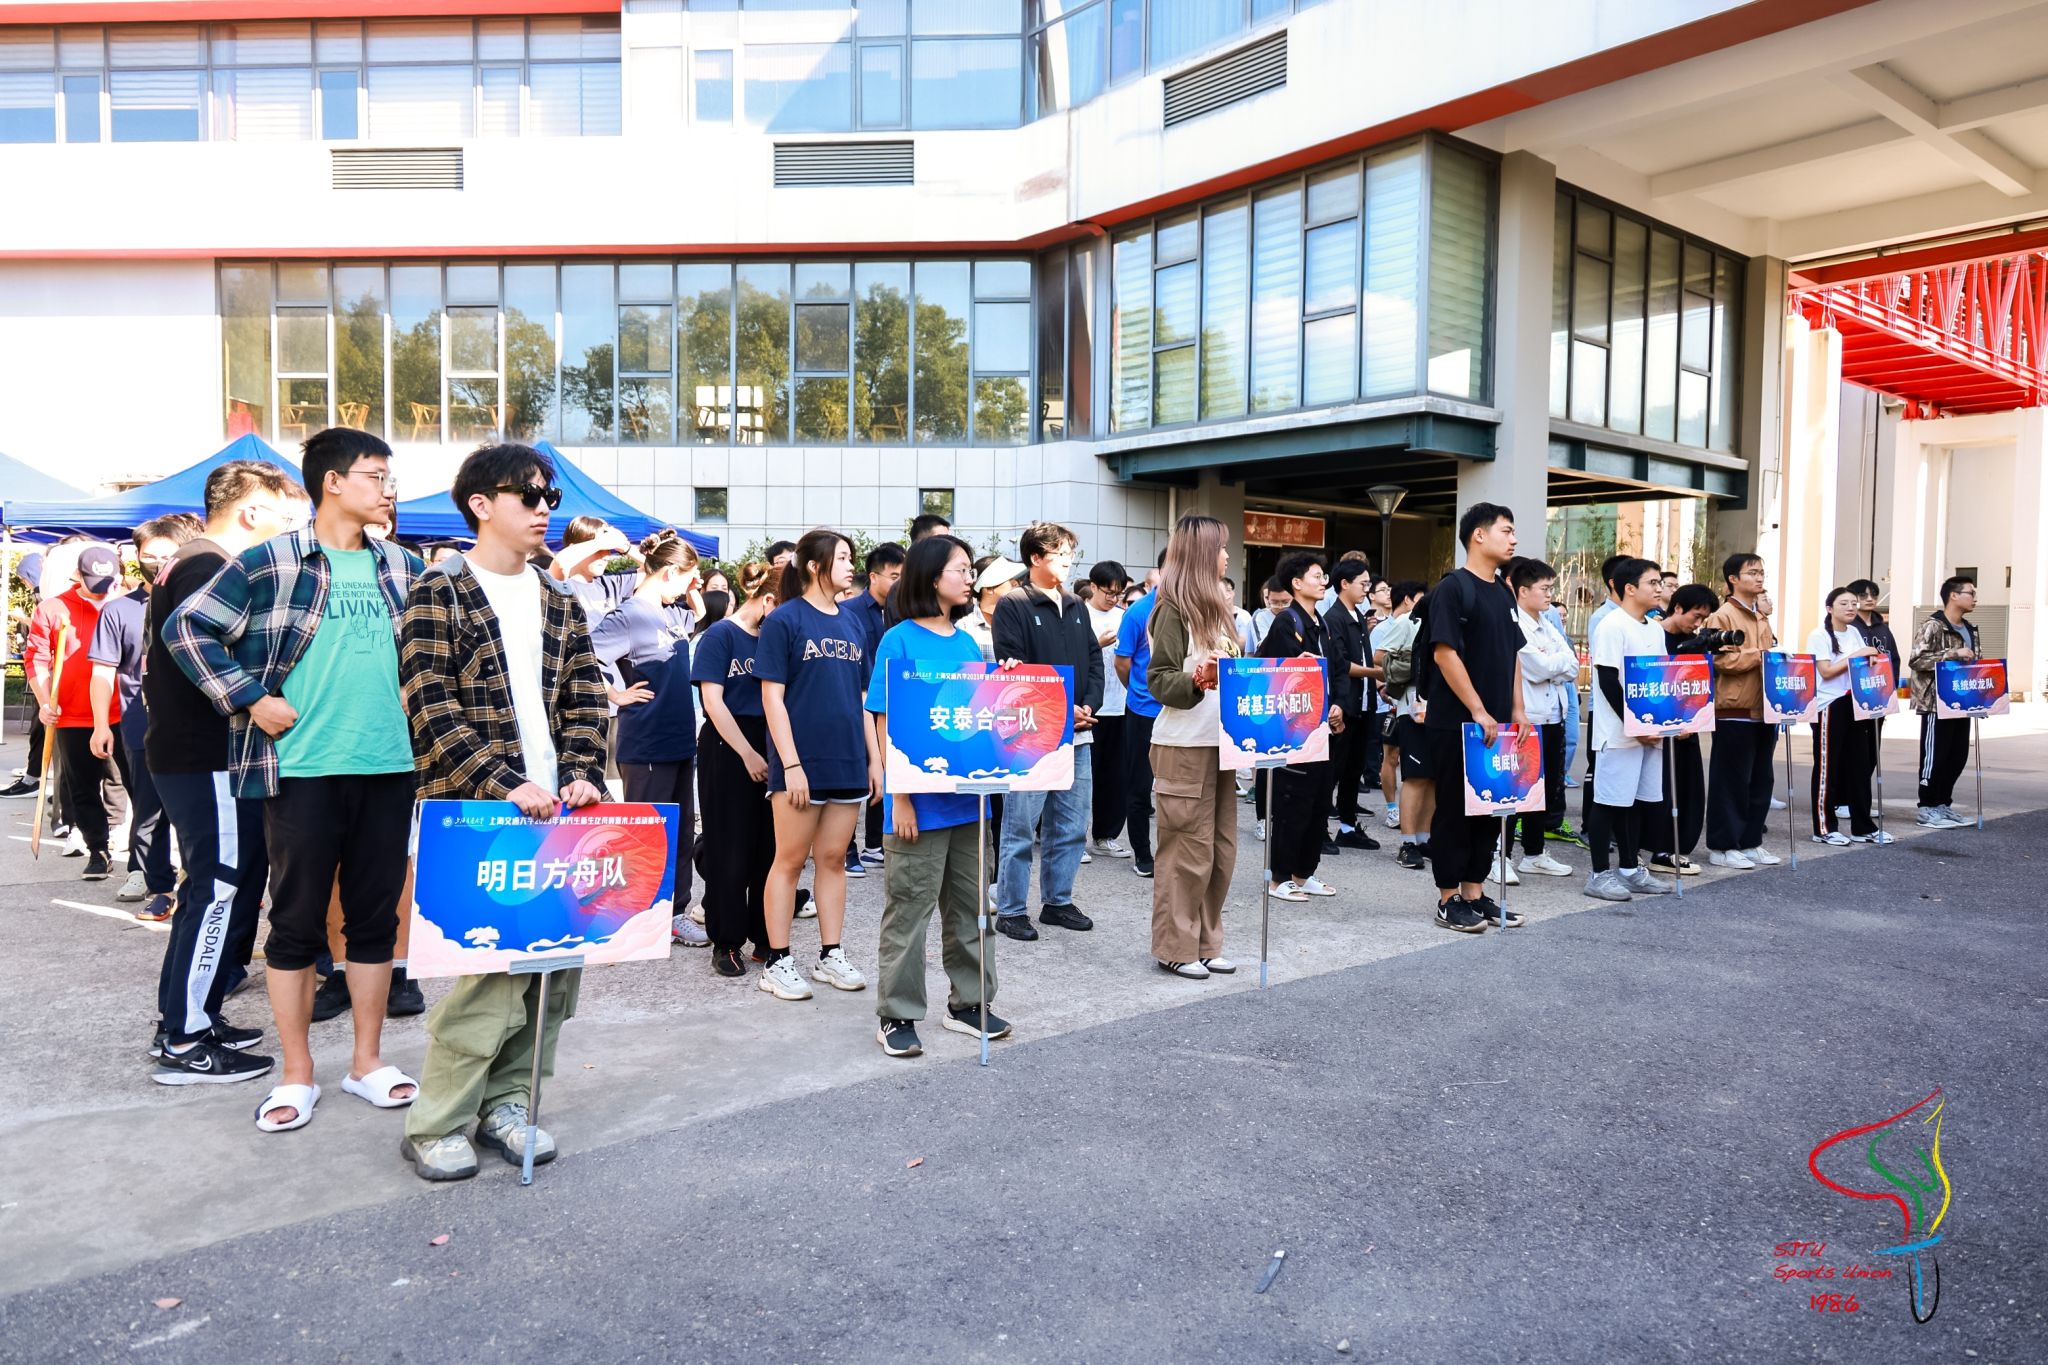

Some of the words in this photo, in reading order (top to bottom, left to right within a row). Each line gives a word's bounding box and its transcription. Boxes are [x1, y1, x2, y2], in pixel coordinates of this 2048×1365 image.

[1627, 680, 1711, 699] 阳光彩虹小白龙队
[1237, 693, 1313, 716] 碱基互补配队
[929, 706, 1038, 731] 安泰合一队
[1492, 754, 1520, 771] 电底队
[477, 857, 627, 892] 明日方舟队
[198, 900, 227, 972] LONSDALE
